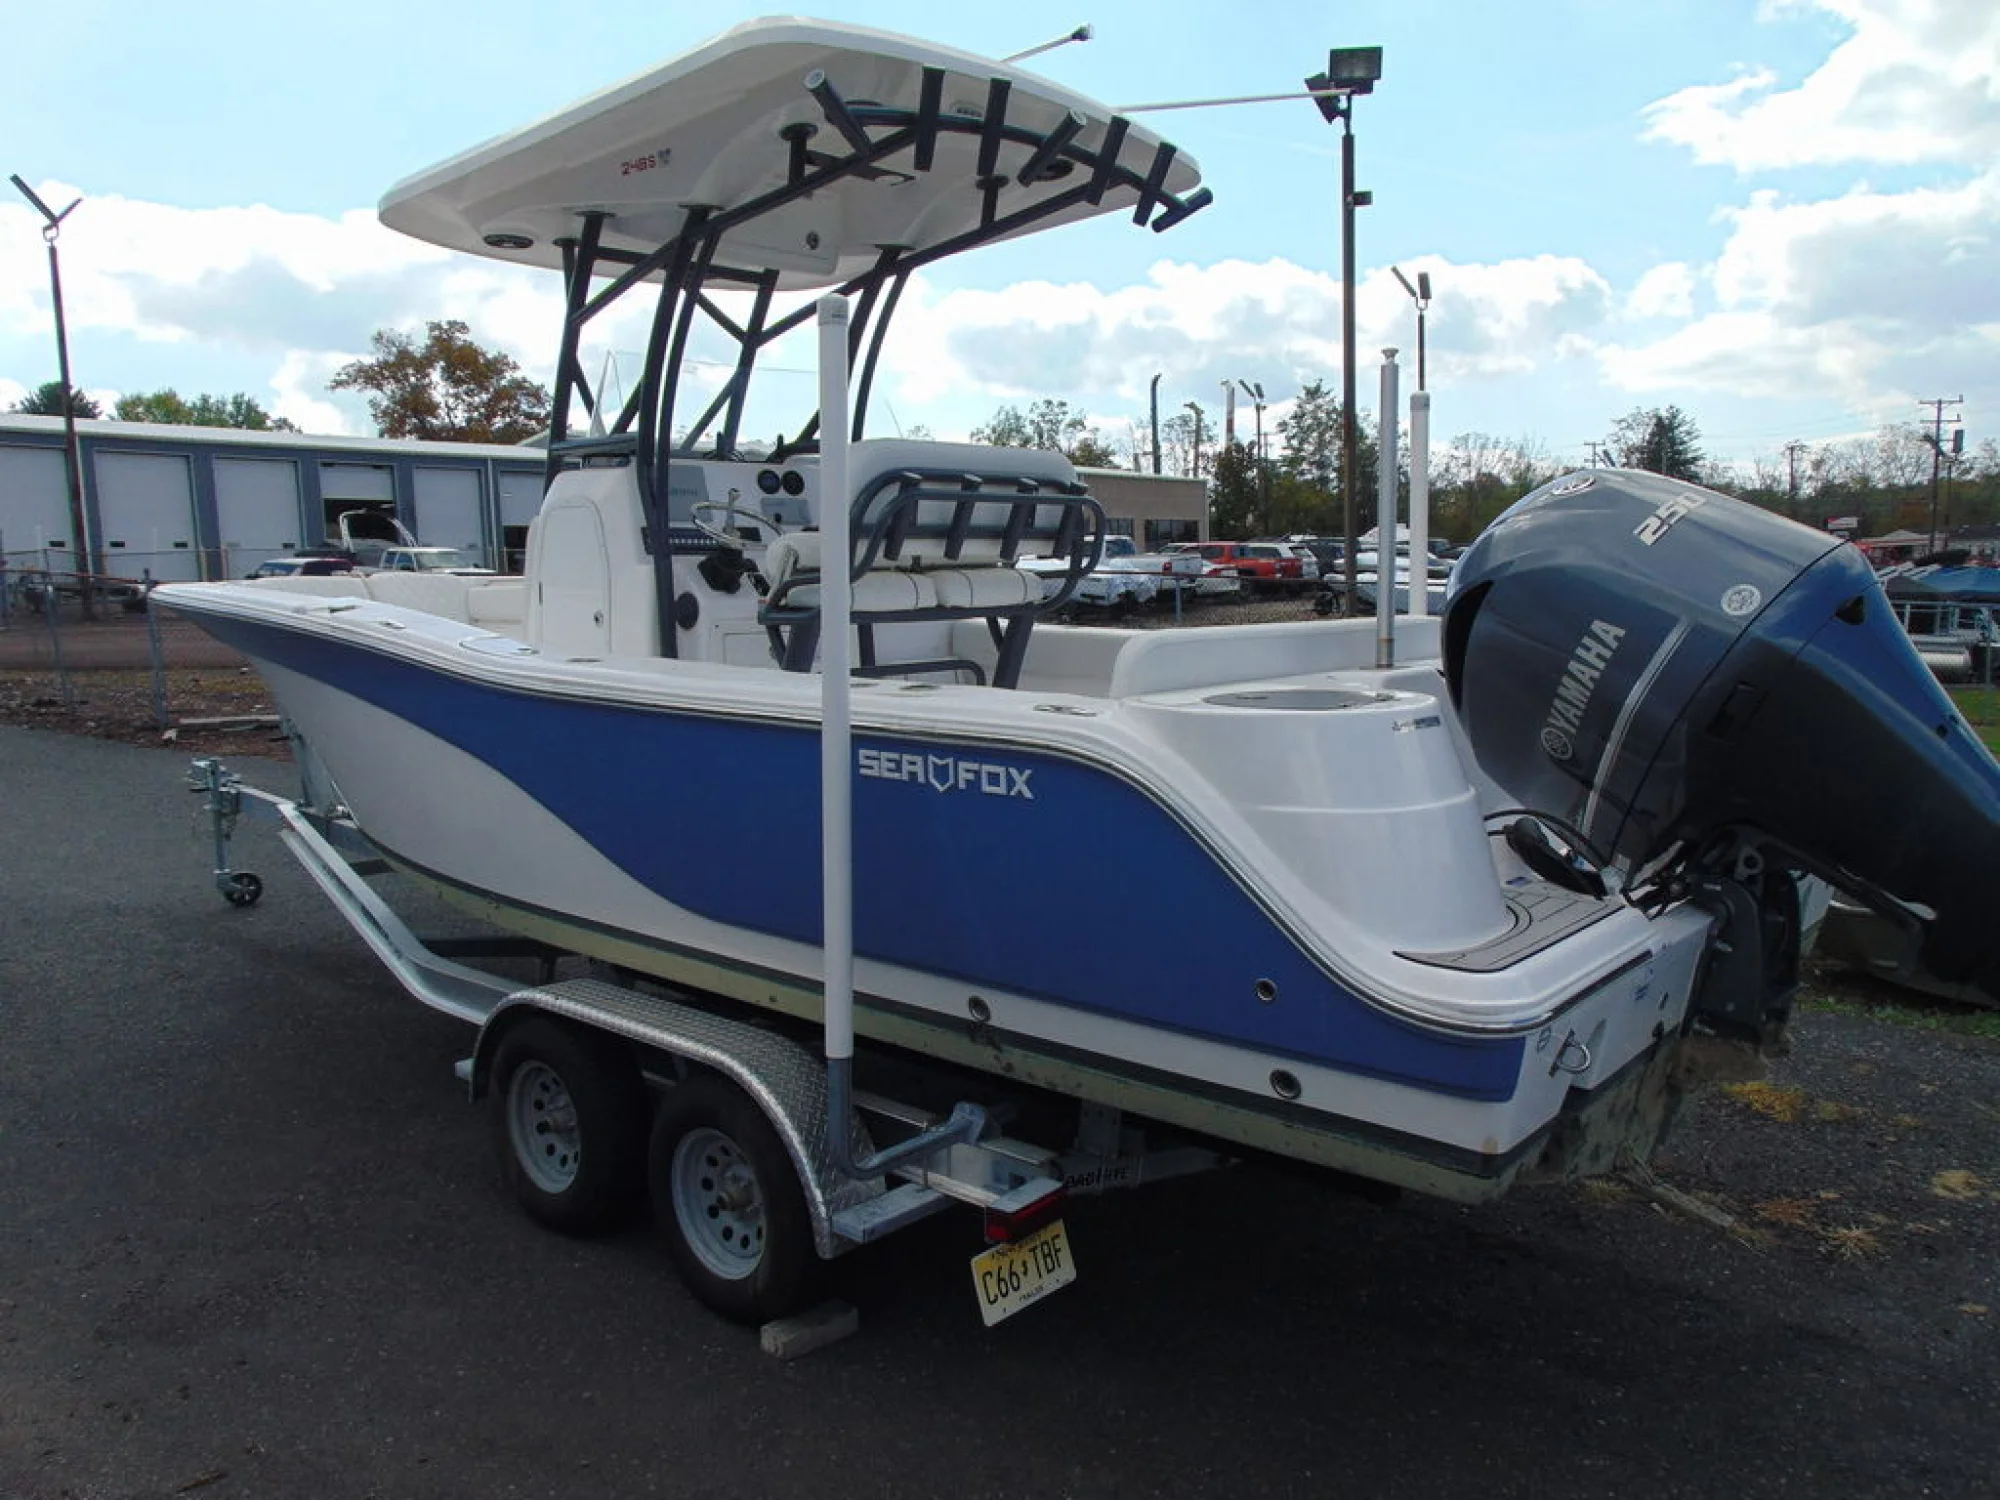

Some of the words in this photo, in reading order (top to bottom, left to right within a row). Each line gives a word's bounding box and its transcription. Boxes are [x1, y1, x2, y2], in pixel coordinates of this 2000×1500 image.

[1632, 491, 1707, 546] 250
[1546, 620, 1626, 735] YAMAHA
[858, 749, 926, 784] SEA
[958, 761, 1034, 800] FOX
